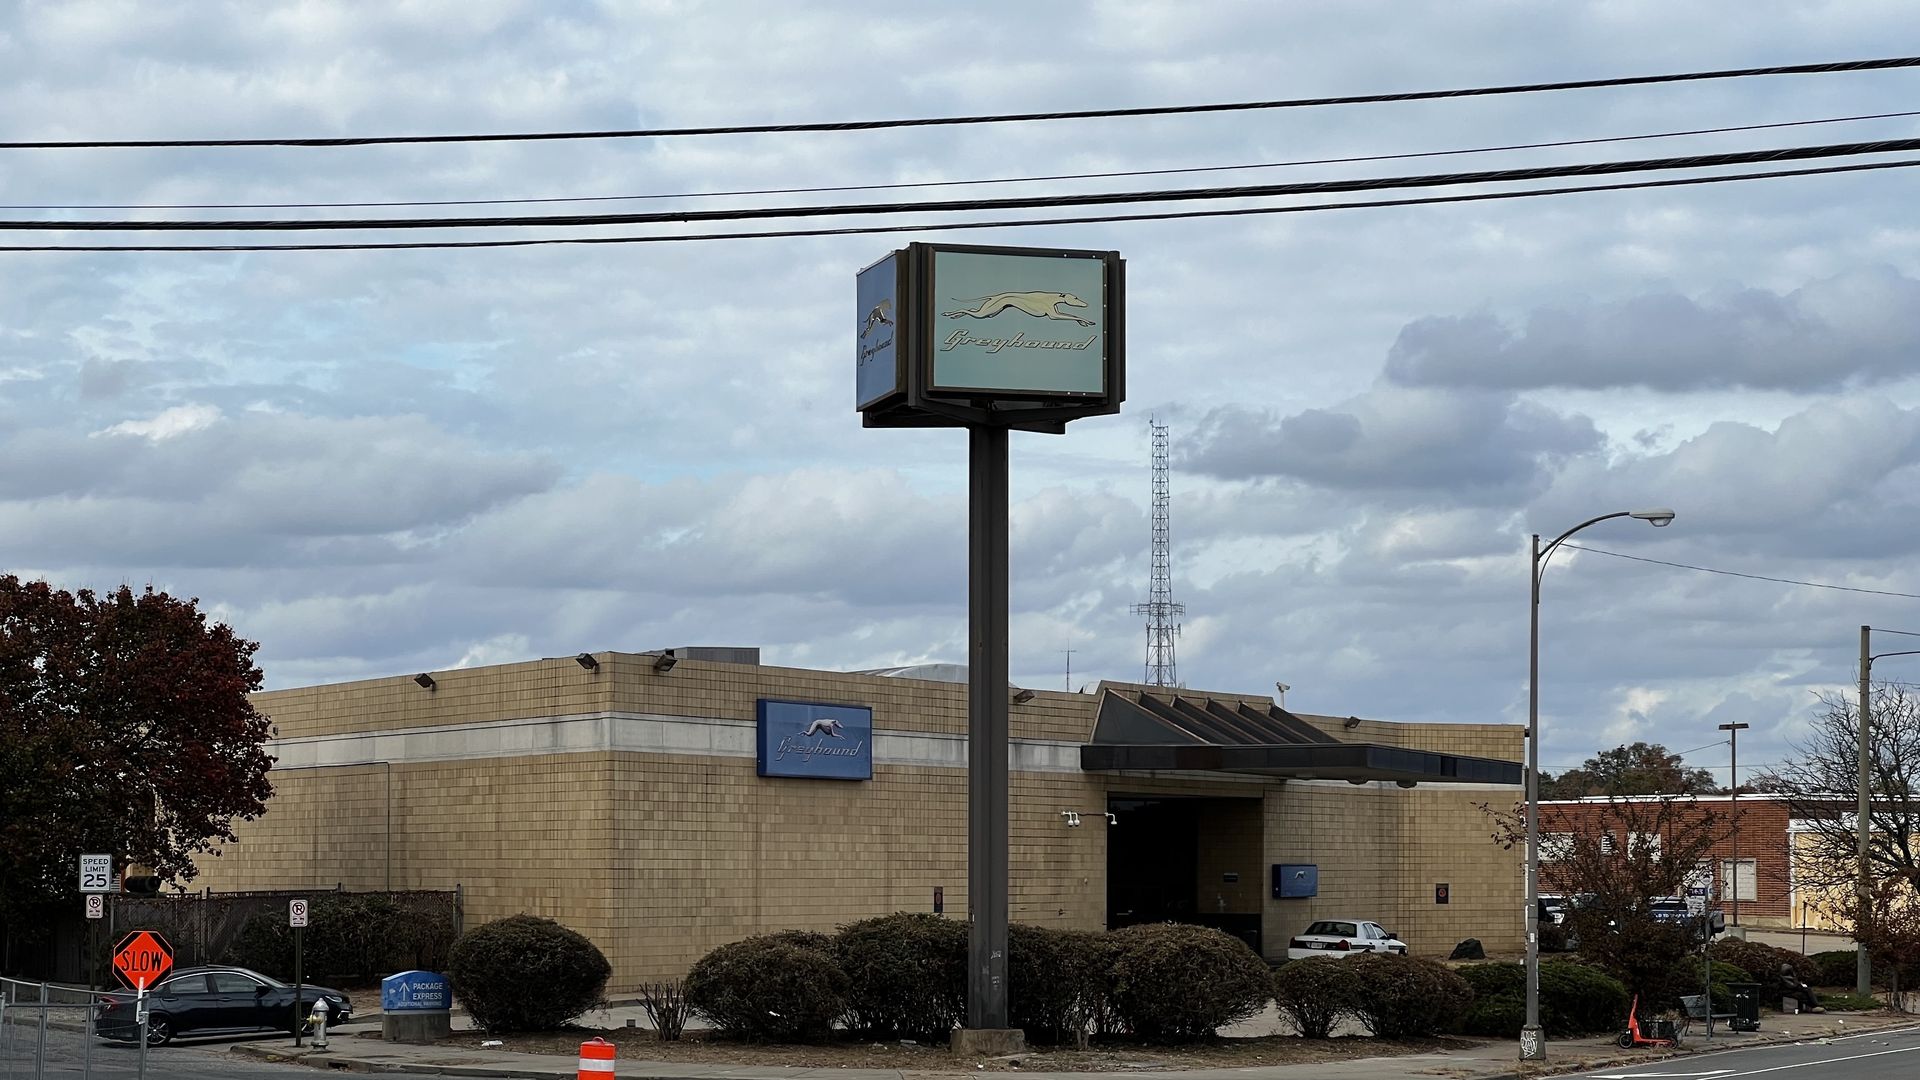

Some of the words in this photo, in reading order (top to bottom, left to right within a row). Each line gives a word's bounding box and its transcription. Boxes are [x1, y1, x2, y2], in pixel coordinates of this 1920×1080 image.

[860, 330, 894, 366] Greyhound
[939, 328, 1098, 354] Greyhound
[775, 735, 863, 762] Greyhound
[83, 873, 107, 887] 25
[121, 950, 163, 972] SLOW
[412, 982, 443, 990] PACKAGE
[412, 992, 442, 1000] EXPRESS
